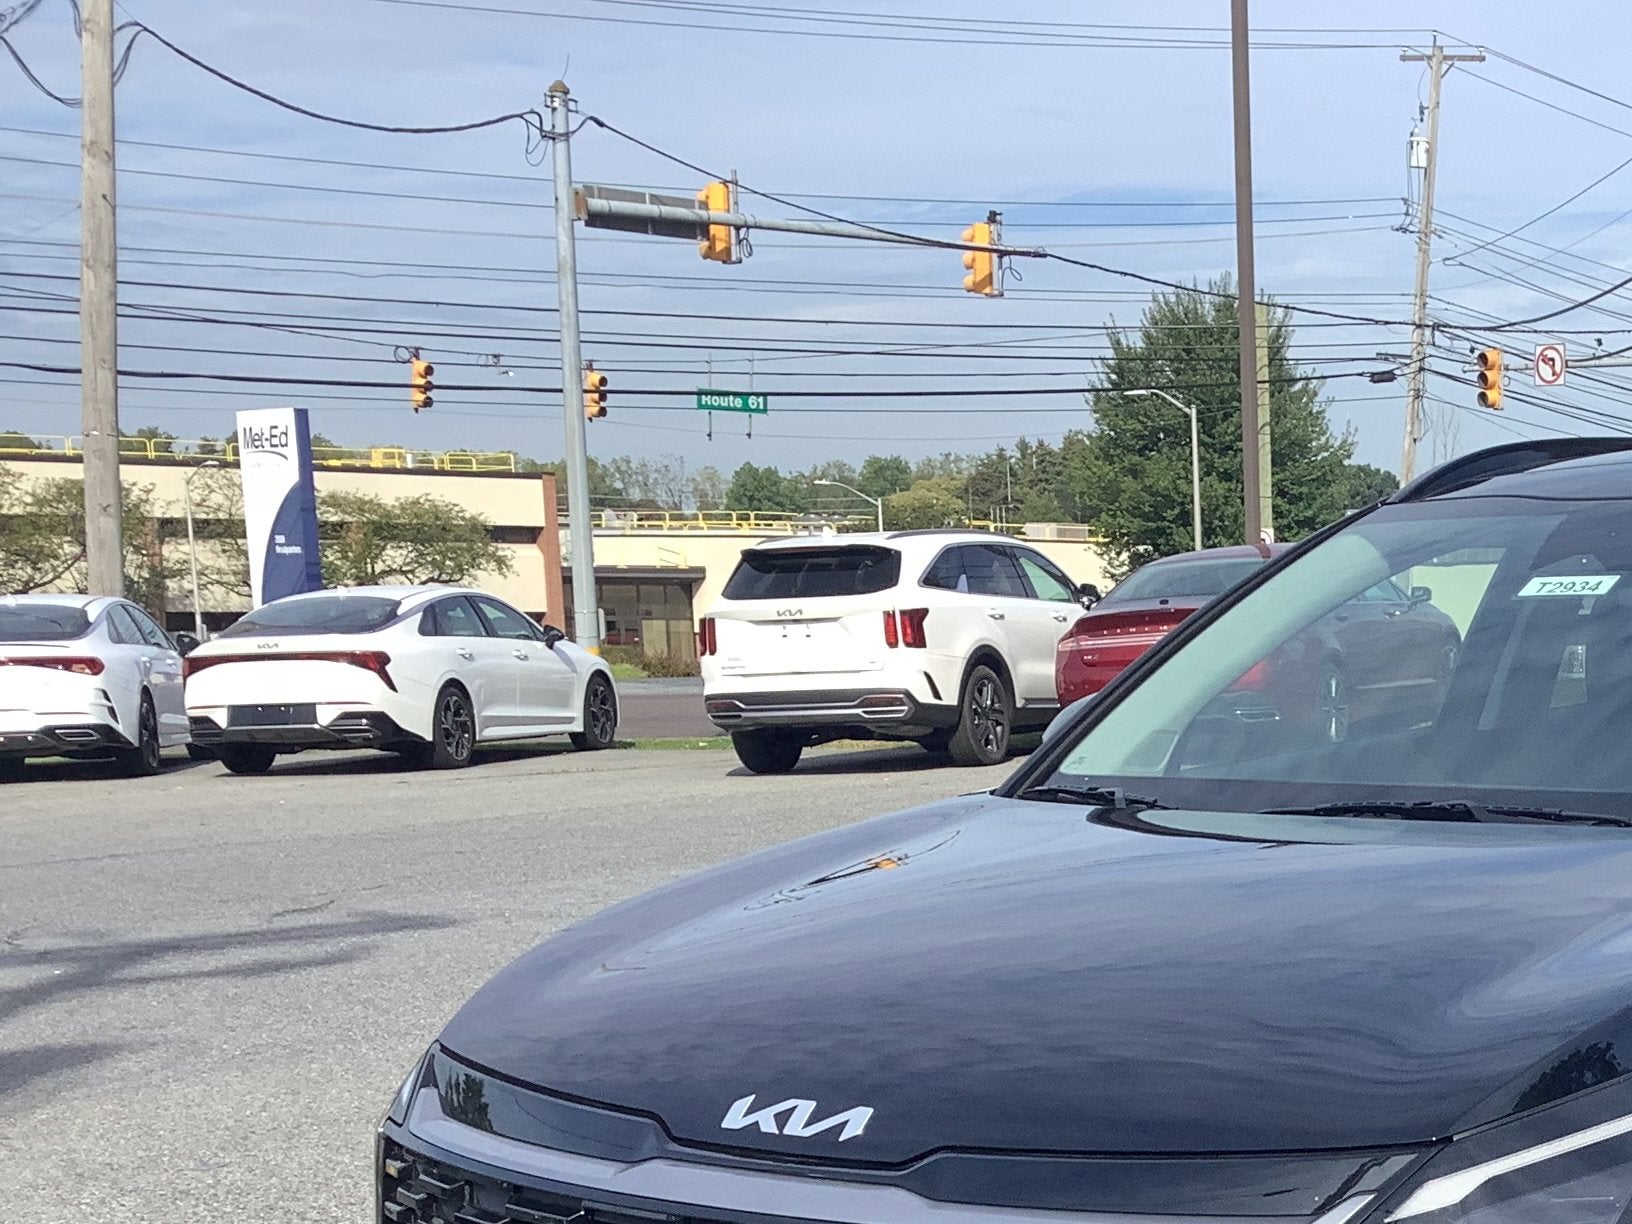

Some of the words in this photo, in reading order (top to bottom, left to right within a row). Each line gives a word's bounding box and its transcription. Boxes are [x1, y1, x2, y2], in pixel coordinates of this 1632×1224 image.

[701, 394, 743, 408] Route
[748, 396, 764, 409] 61
[243, 425, 288, 449] Met-Ed
[1535, 580, 1603, 594] T2934
[720, 1093, 874, 1142] KIA
